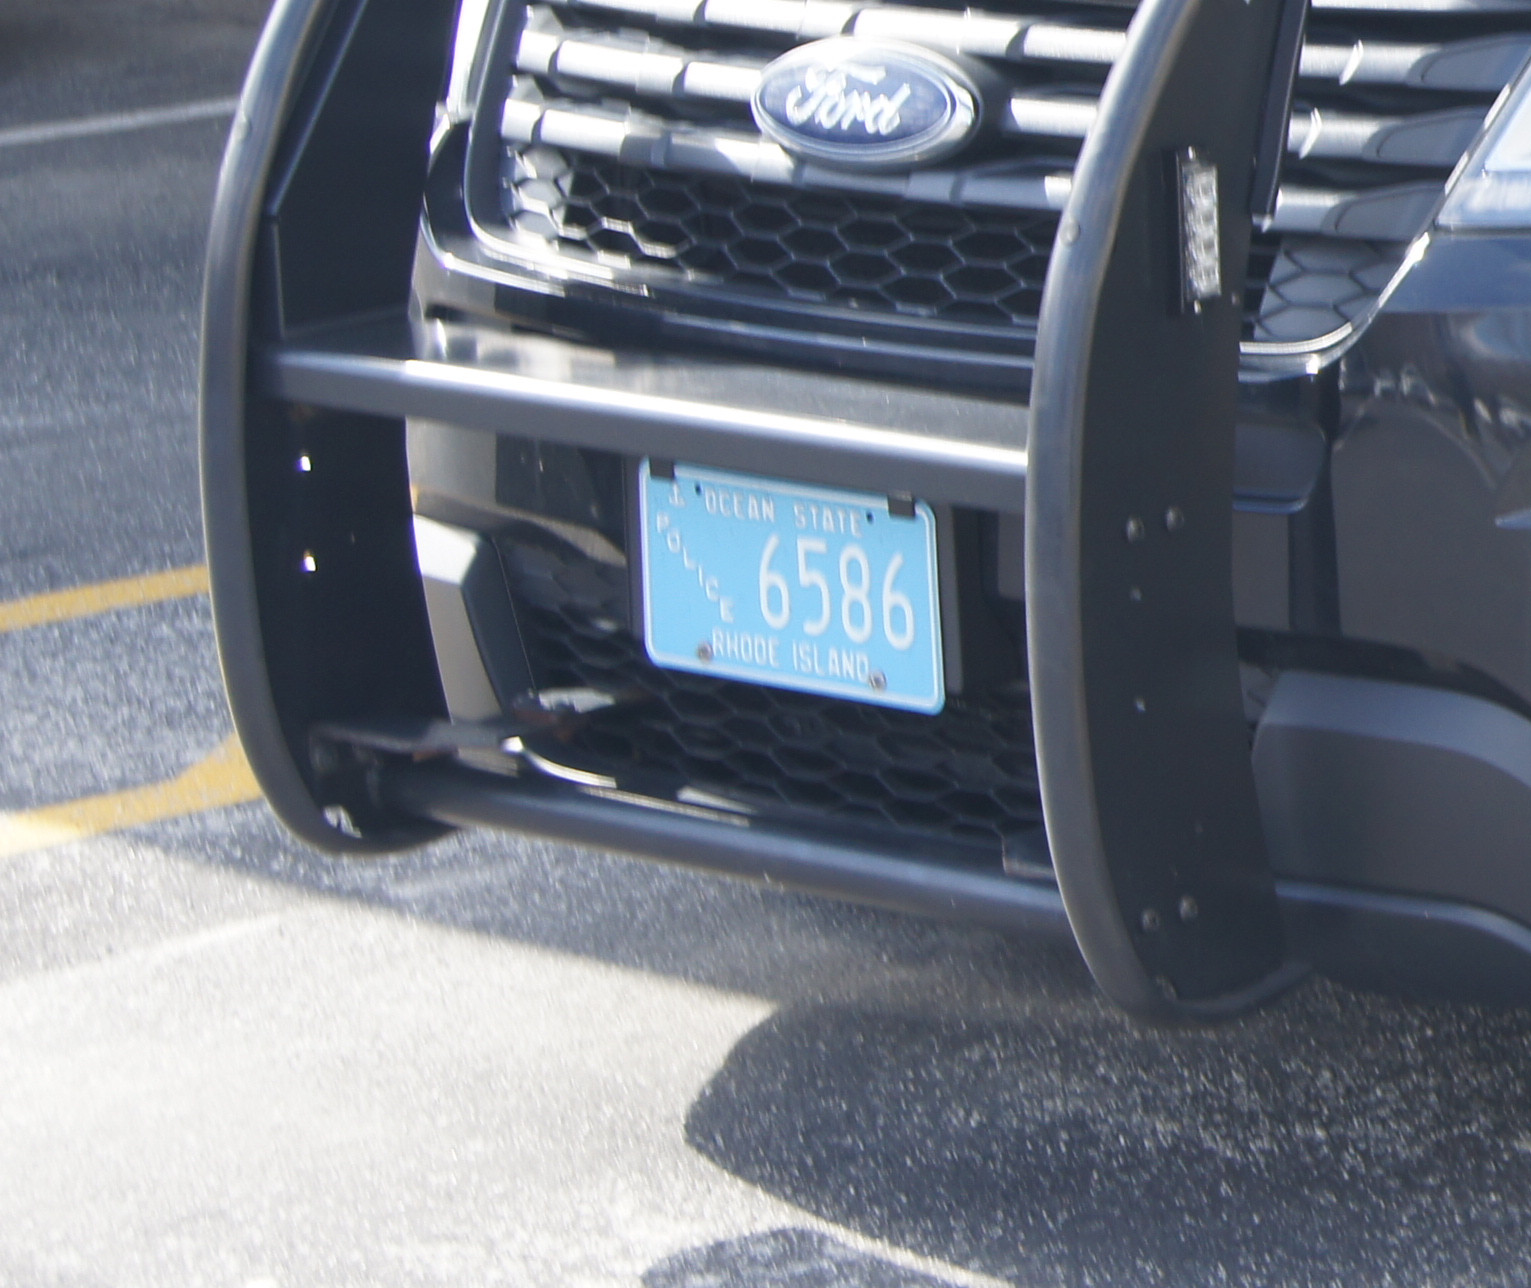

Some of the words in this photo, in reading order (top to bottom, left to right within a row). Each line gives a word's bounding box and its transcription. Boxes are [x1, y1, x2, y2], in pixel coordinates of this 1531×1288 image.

[786, 60, 910, 136] Ford
[705, 488, 775, 523] OCEAN
[794, 503, 862, 538] STATE
[656, 512, 734, 623] POLICE
[759, 534, 914, 651] 6586
[713, 626, 780, 667] RHODE
[792, 639, 869, 682] ISLAND
